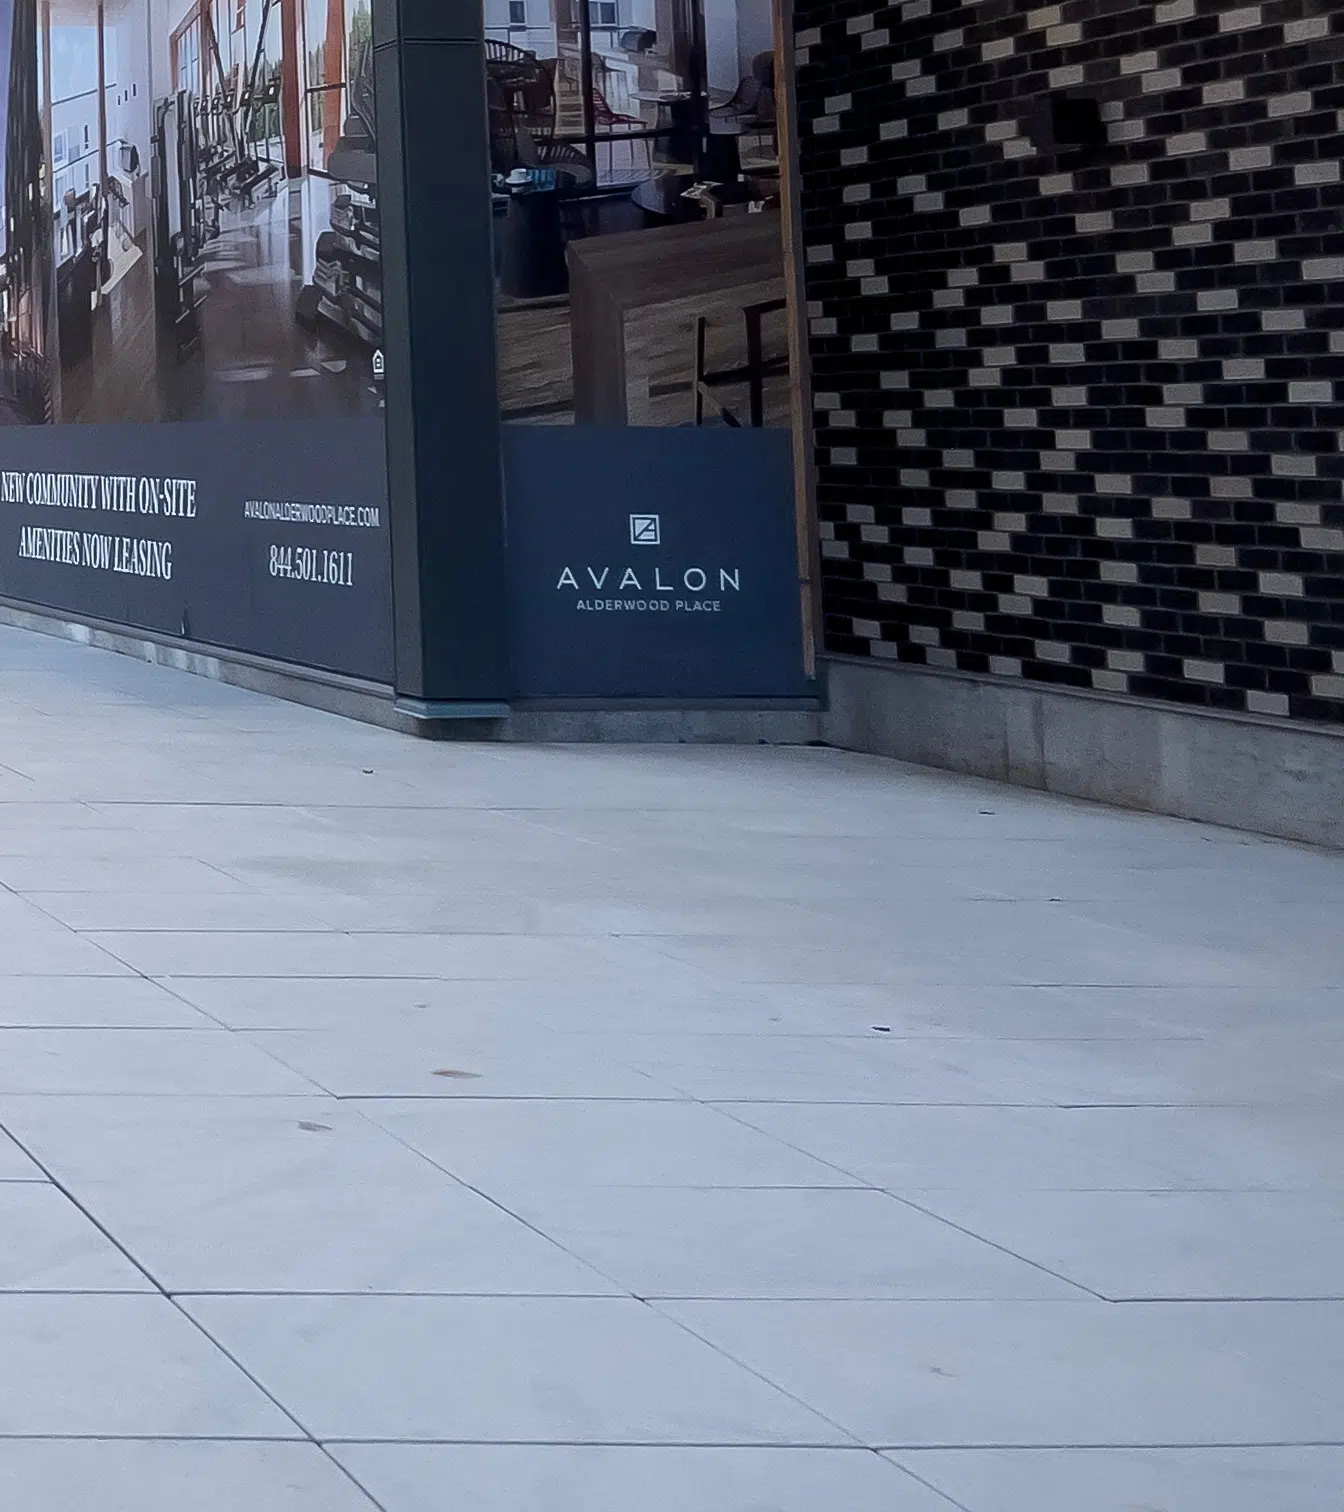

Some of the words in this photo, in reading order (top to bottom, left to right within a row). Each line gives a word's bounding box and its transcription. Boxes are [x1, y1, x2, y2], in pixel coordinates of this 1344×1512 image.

[0, 470, 25, 503] NEW
[25, 472, 99, 510] COMMUNITY
[100, 475, 137, 513] WITH
[138, 476, 197, 518] ON-SITE
[244, 499, 380, 527] AVALONALDERWOODPLACE.COM
[18, 525, 80, 566] AMENITIES
[81, 532, 112, 570] NOW
[113, 536, 173, 581] LEASING
[269, 544, 354, 587] 844.501.1611
[556, 566, 740, 592] AVALON
[575, 598, 670, 612] ALDERWOOD
[675, 600, 722, 613] PLACE
